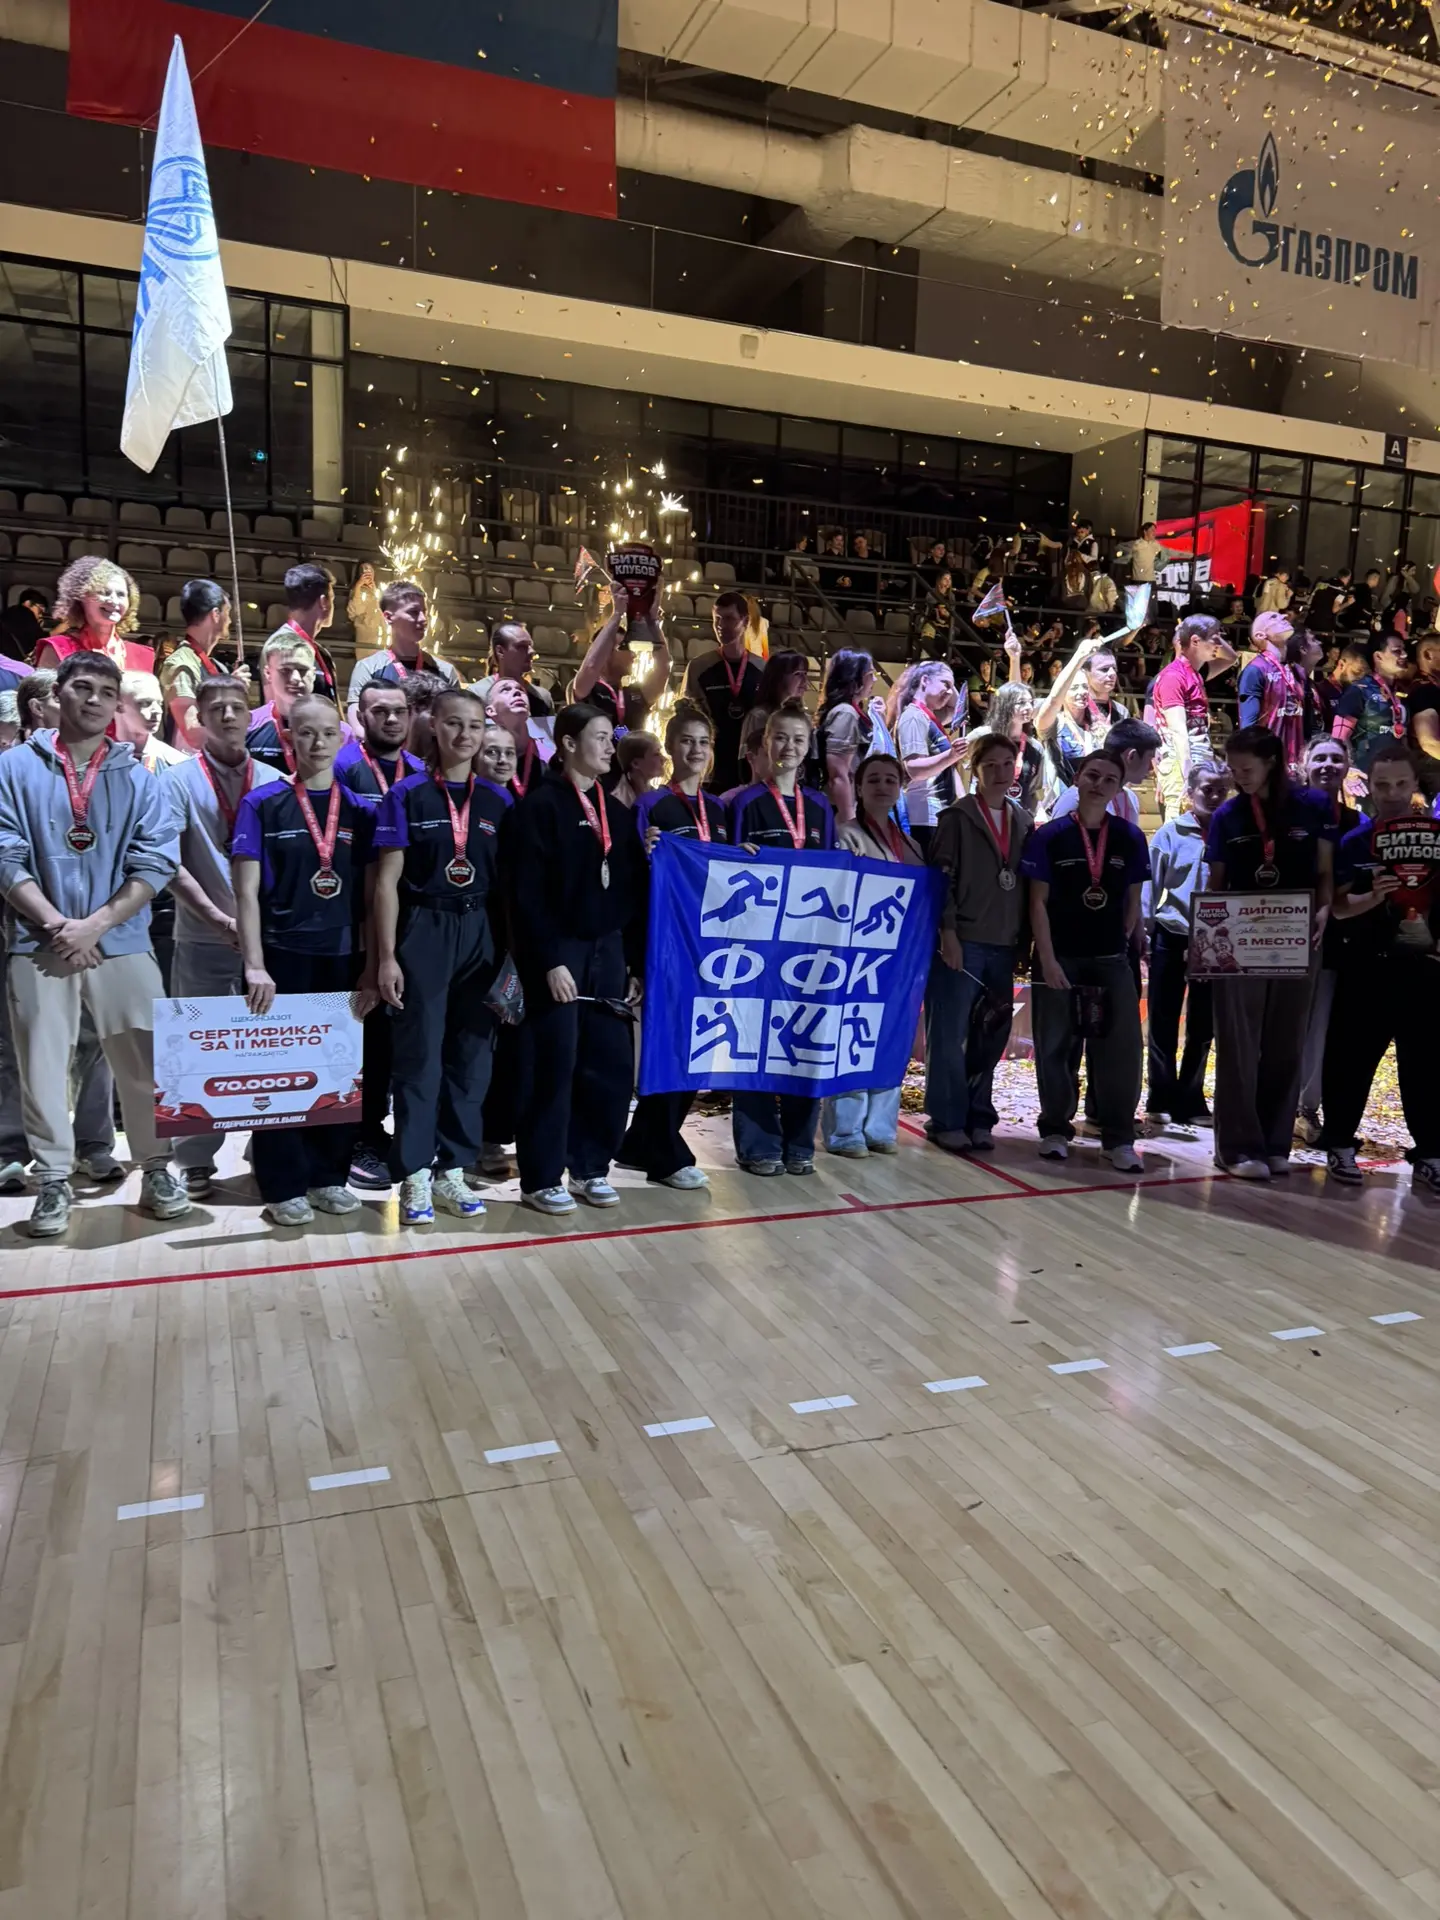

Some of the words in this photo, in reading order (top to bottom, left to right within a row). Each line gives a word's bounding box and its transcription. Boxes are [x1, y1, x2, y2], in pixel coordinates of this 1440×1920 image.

[1280, 225, 1418, 300] ГАЗПРОМ
[609, 554, 659, 567] БИТВА
[615, 565, 656, 577] КЛУБОВ
[632, 587, 641, 596] 2
[1407, 875, 1419, 887] 2
[1238, 906, 1308, 916] ДИПЛОМ
[1238, 938, 1247, 946] 2
[1251, 937, 1307, 946] МЕСТО
[698, 943, 766, 991] Ф
[780, 949, 893, 995] ФК
[188, 1024, 333, 1041] СЕРТИФИКАТ
[201, 1041, 229, 1051] ЗА
[251, 1036, 322, 1049] МЕСТО
[213, 1076, 291, 1092] 70.000
